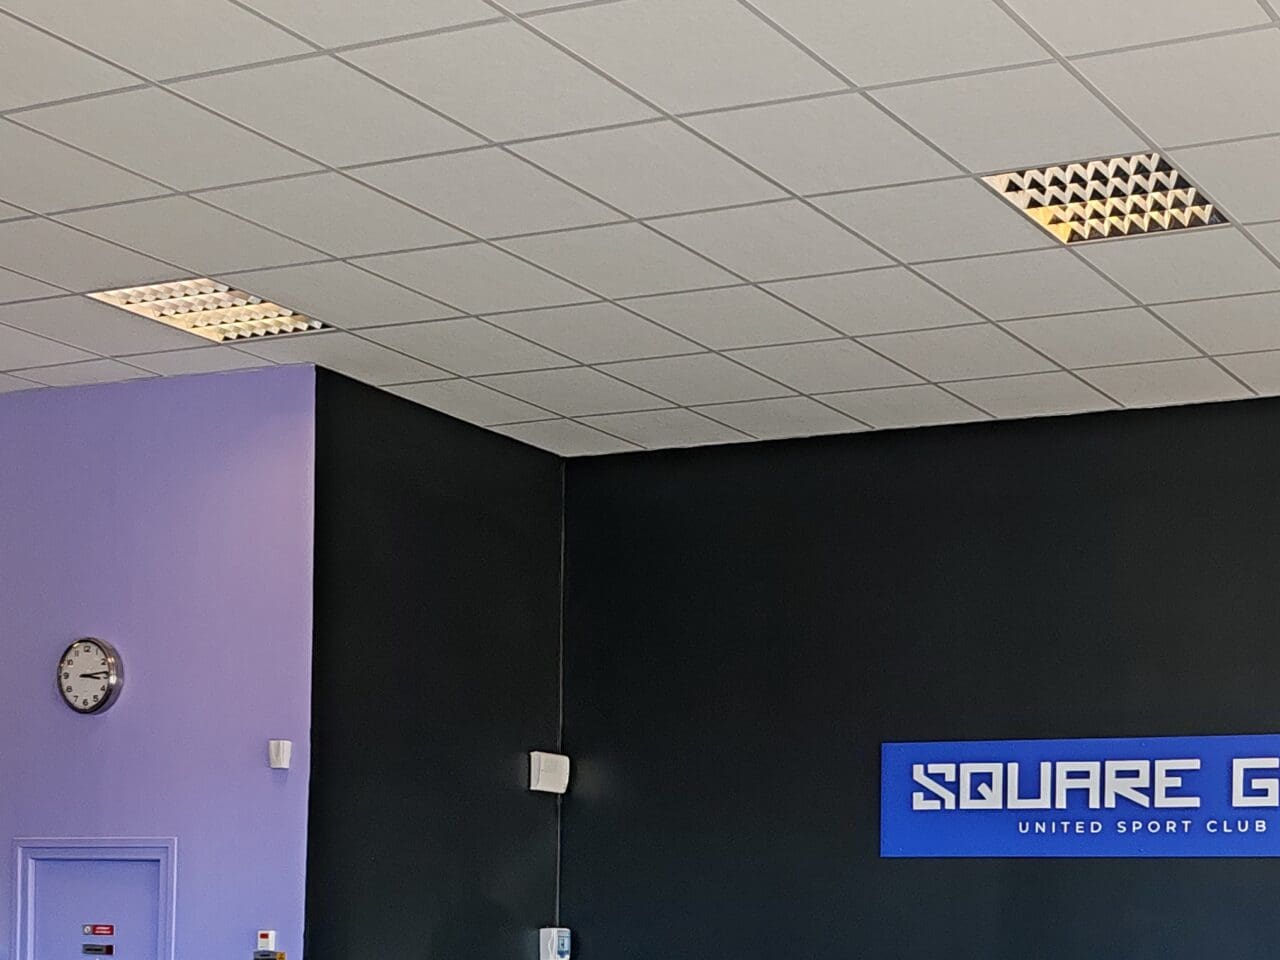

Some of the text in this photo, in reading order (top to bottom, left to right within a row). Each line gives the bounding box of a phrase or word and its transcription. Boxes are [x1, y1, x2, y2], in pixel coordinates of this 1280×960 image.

[912, 759, 1201, 811] SQUARE
[1018, 820, 1268, 834] UNITED SPORT CLUB
